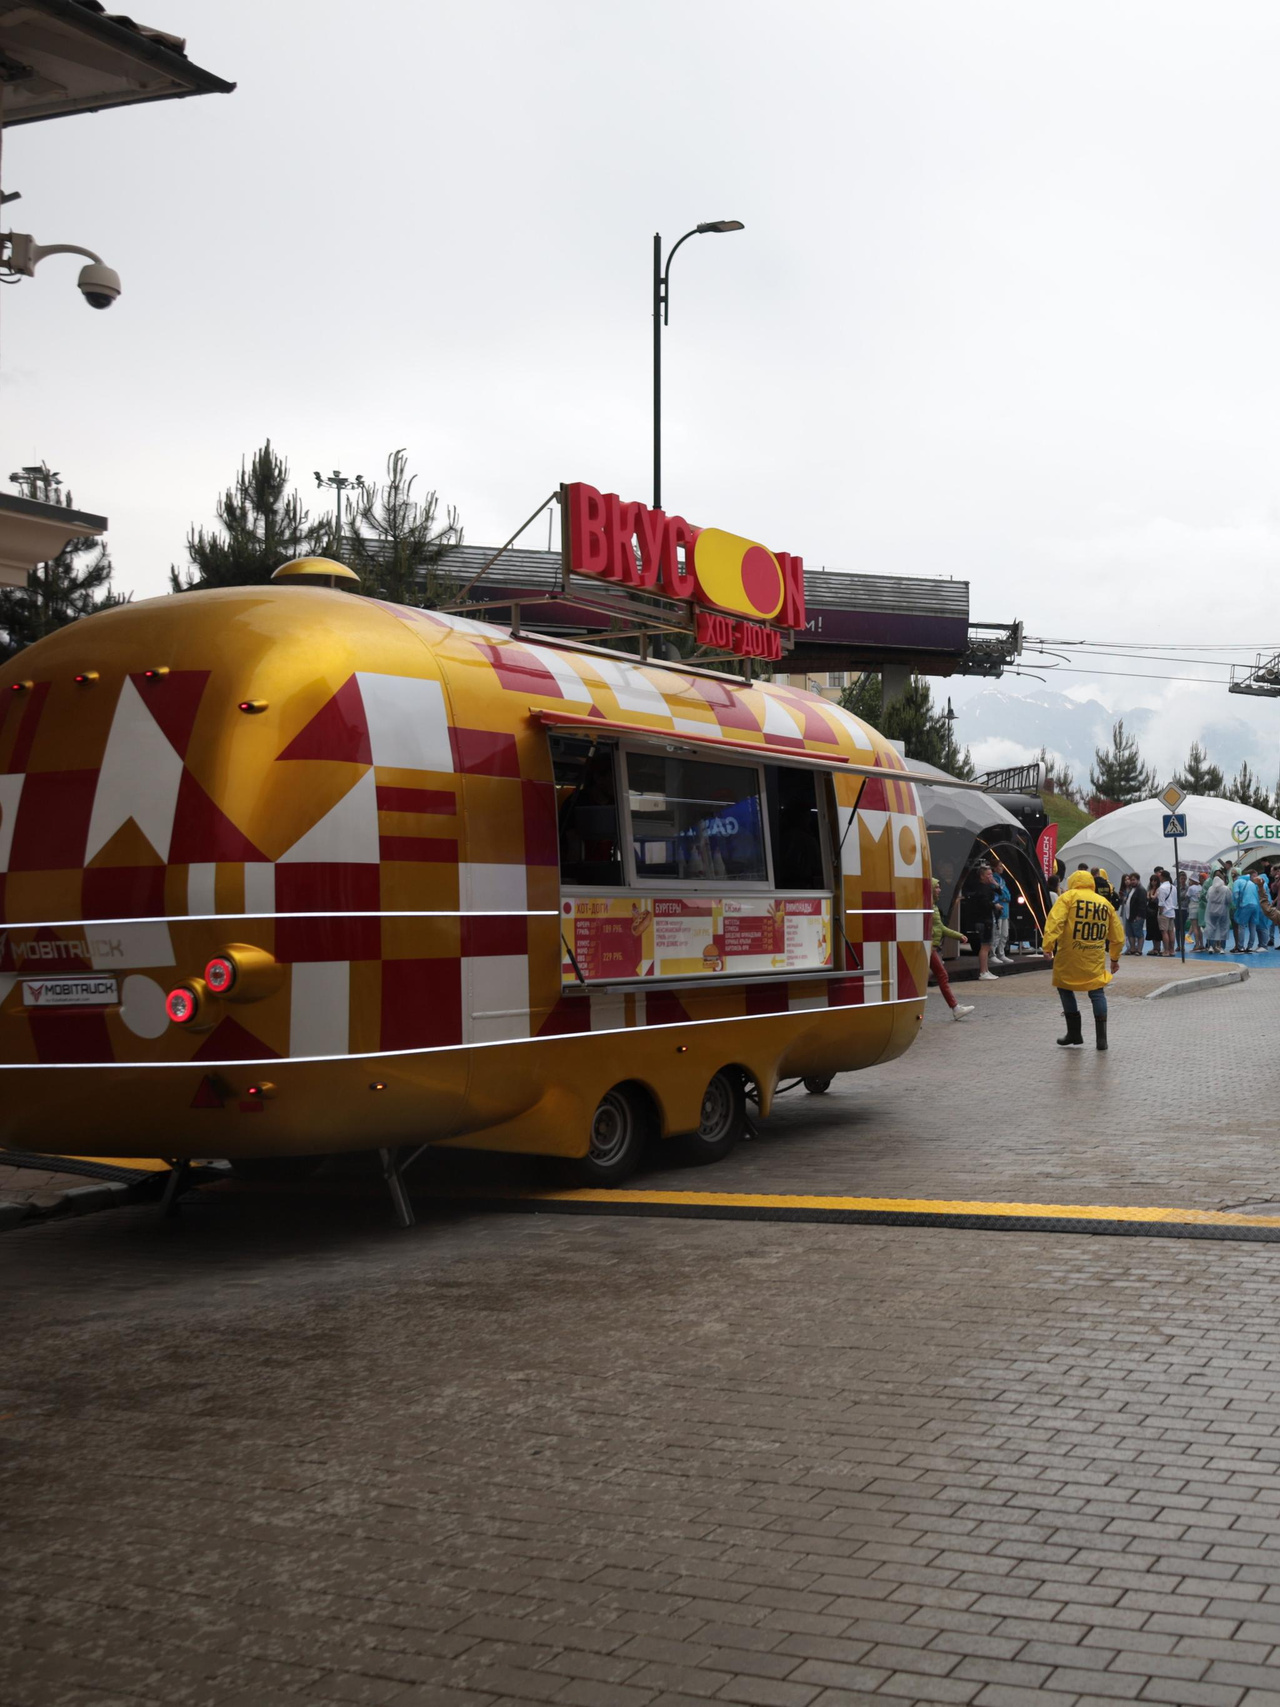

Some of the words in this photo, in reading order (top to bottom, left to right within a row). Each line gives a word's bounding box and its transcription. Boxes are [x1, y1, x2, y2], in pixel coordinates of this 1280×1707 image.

[698, 613, 782, 661] ХОТ-ДОГИ
[576, 903, 609, 915] ХОТ-ДОГИ
[655, 903, 682, 914] БУРГЕРЫ
[1075, 899, 1109, 922] EFKO
[1072, 920, 1107, 941] FOOD
[10, 939, 124, 960] MOBITRUCK
[45, 982, 115, 996] MOBITRUCK
